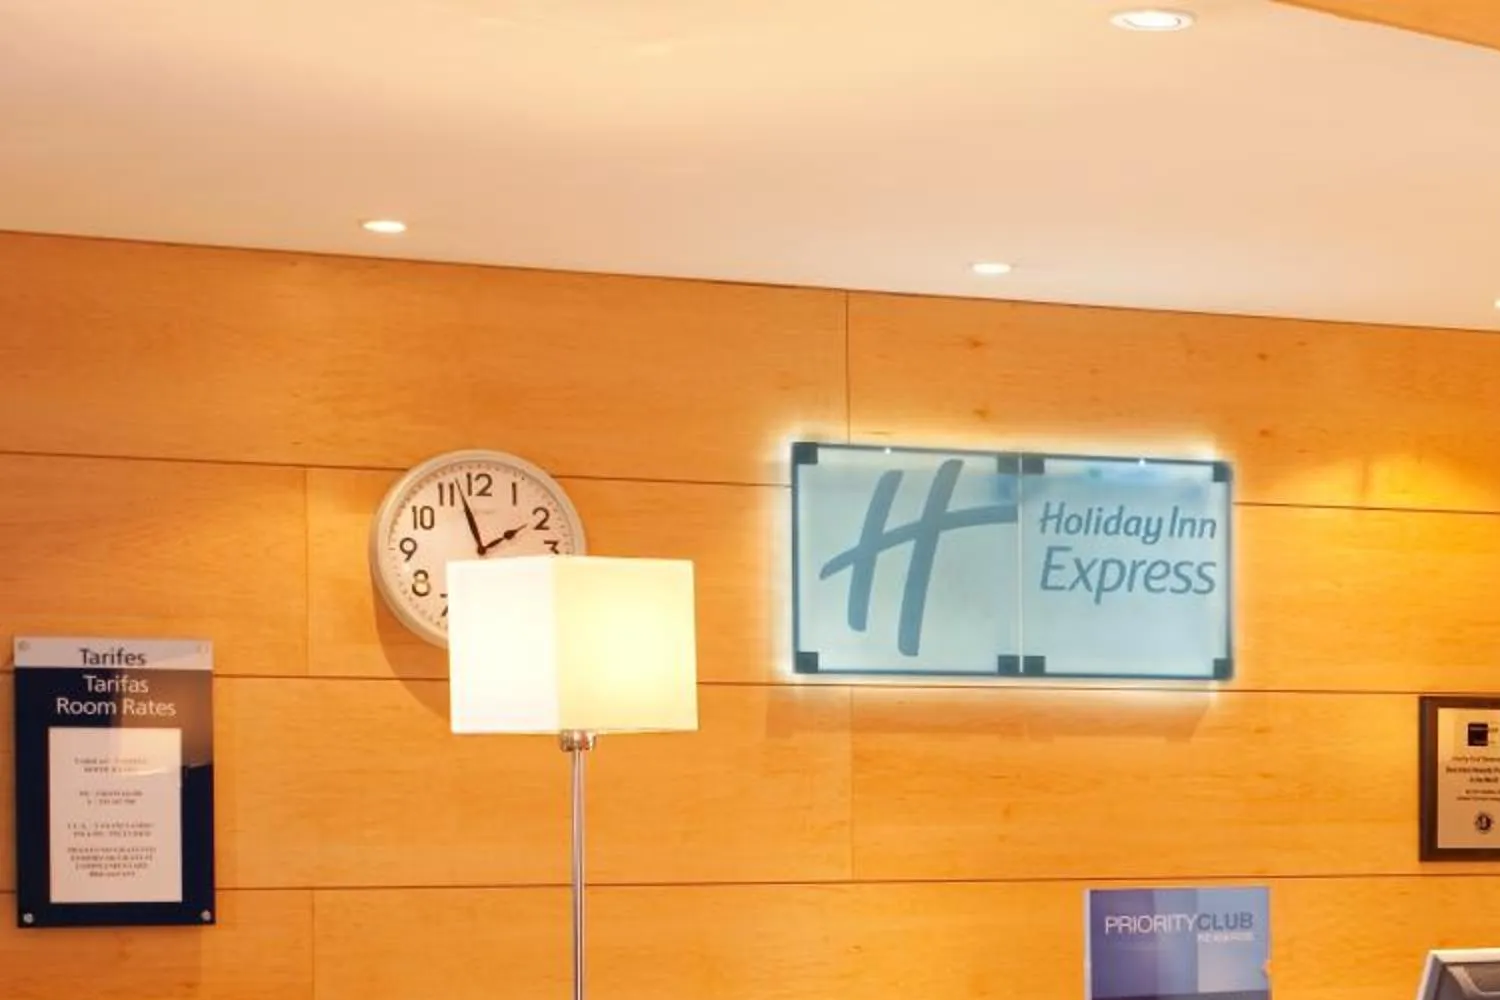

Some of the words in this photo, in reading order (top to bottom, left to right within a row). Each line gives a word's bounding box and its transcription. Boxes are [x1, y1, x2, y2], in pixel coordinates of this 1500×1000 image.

[437, 482, 455, 507] 11
[466, 472, 493, 497] 12
[511, 482, 518, 506] 1
[411, 505, 435, 530] 10
[532, 506, 550, 531] 2
[1039, 501, 1162, 544] Holiday
[1169, 506, 1217, 539] Inn
[399, 537, 418, 562] 9
[411, 569, 431, 597] 8
[1039, 546, 1217, 604] Express
[79, 647, 147, 667] Tarifes
[82, 674, 150, 694] Tarifas
[56, 697, 117, 716] Room
[122, 698, 177, 717] Rates
